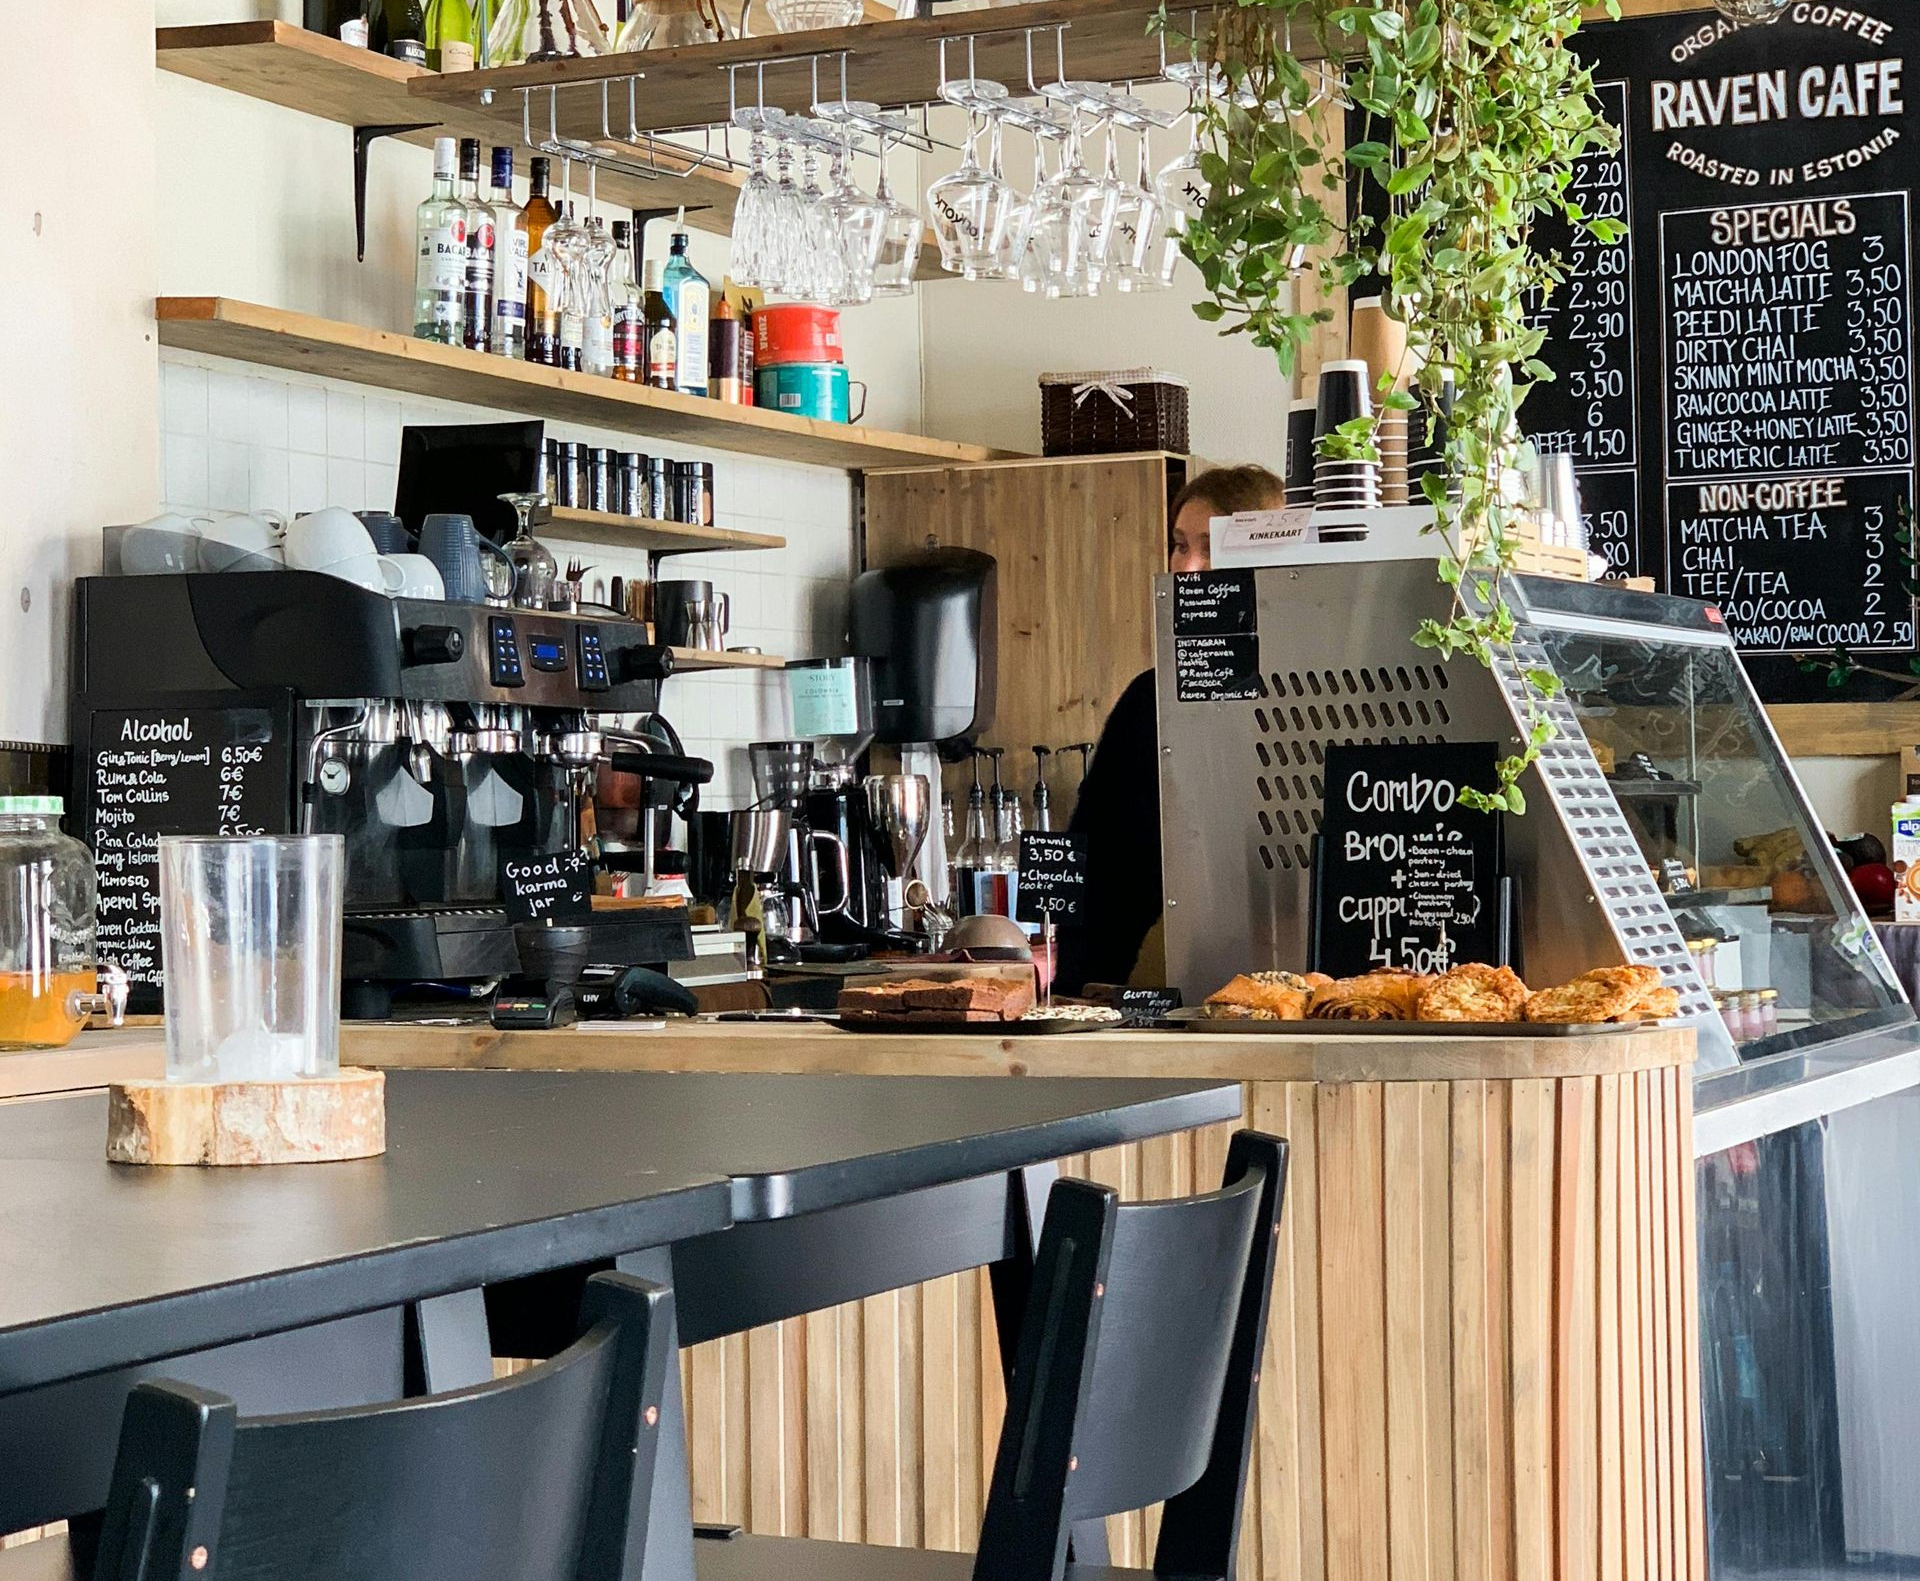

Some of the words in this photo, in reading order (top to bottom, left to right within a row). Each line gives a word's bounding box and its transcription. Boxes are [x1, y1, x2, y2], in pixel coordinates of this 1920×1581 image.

[1792, 3, 1893, 45] COFFEE
[1651, 70, 1788, 131] RAVEN
[1798, 58, 1903, 118] CAFE
[1666, 141, 1760, 186] ROASTED
[1769, 168, 1793, 185] IN
[1802, 126, 1900, 182] ESTONIA
[1573, 161, 1622, 188] 2,20
[1710, 199, 1856, 246] SPECIALS
[1570, 248, 1625, 277] 2,60
[1672, 246, 1773, 279] LONDON
[1776, 240, 1830, 272] FOG
[1862, 235, 1884, 262] 3
[1569, 280, 1625, 309] 2,90
[1673, 275, 1766, 308] MATCHA
[1766, 273, 1833, 304] LATTE
[1846, 264, 1901, 297] 3,50
[1569, 312, 1624, 340] 2,90
[1672, 309, 1741, 338] PEEDI
[1745, 304, 1823, 335] LATTE
[1847, 297, 1902, 328] 3,50
[1586, 342, 1606, 369] 3
[1675, 339, 1737, 363] DIRTY
[1742, 334, 1796, 361] CHAI
[1849, 328, 1902, 354] 3,50
[1570, 369, 1623, 399] 3,50
[1674, 362, 1743, 390] SKINNY
[1747, 359, 1794, 385] MINT
[1797, 356, 1858, 383] MOCHA
[1860, 355, 1906, 384] 3,50
[1780, 387, 1833, 413] LATTE
[1860, 383, 1906, 410] 3,50
[1587, 401, 1604, 427] 6
[1817, 413, 1866, 437] LATTE
[1867, 411, 1907, 438] 3,50
[1582, 429, 1625, 459] 1,50
[1674, 445, 1785, 469] TURMERIC
[1788, 443, 1840, 466] LATTE
[1862, 437, 1909, 464] 3,50
[1249, 528, 1303, 541] KINKEKAART
[1680, 515, 1769, 544] MATCHA
[1773, 511, 1827, 540] TEA
[1864, 506, 1884, 531] 3
[1682, 546, 1734, 571] CHAI
[1865, 533, 1884, 559] 3
[1682, 566, 1790, 599] TEE/TEA
[1863, 563, 1884, 587] 2
[1863, 593, 1886, 616] 2
[1816, 622, 1870, 645] COCOA
[1872, 621, 1911, 646] 2,50
[120, 717, 193, 743] Alcohol
[220, 766, 244, 782] 6€
[97, 789, 124, 804] Tom
[125, 787, 169, 804] Collins
[219, 785, 244, 801] 7€
[1347, 770, 1455, 813] Combo
[96, 807, 135, 829] Mojito
[218, 805, 240, 822] 7€
[1901, 821, 1919, 833] alp
[1029, 835, 1072, 847] Brownie
[95, 849, 125, 871] Long
[506, 857, 559, 879] Good
[515, 877, 567, 896] karma
[1028, 869, 1084, 884] Chocolate
[529, 896, 555, 917] jar
[128, 936, 155, 950] Wine
[121, 952, 153, 970] Coffee
[1122, 990, 1159, 1000] GLUTEN
